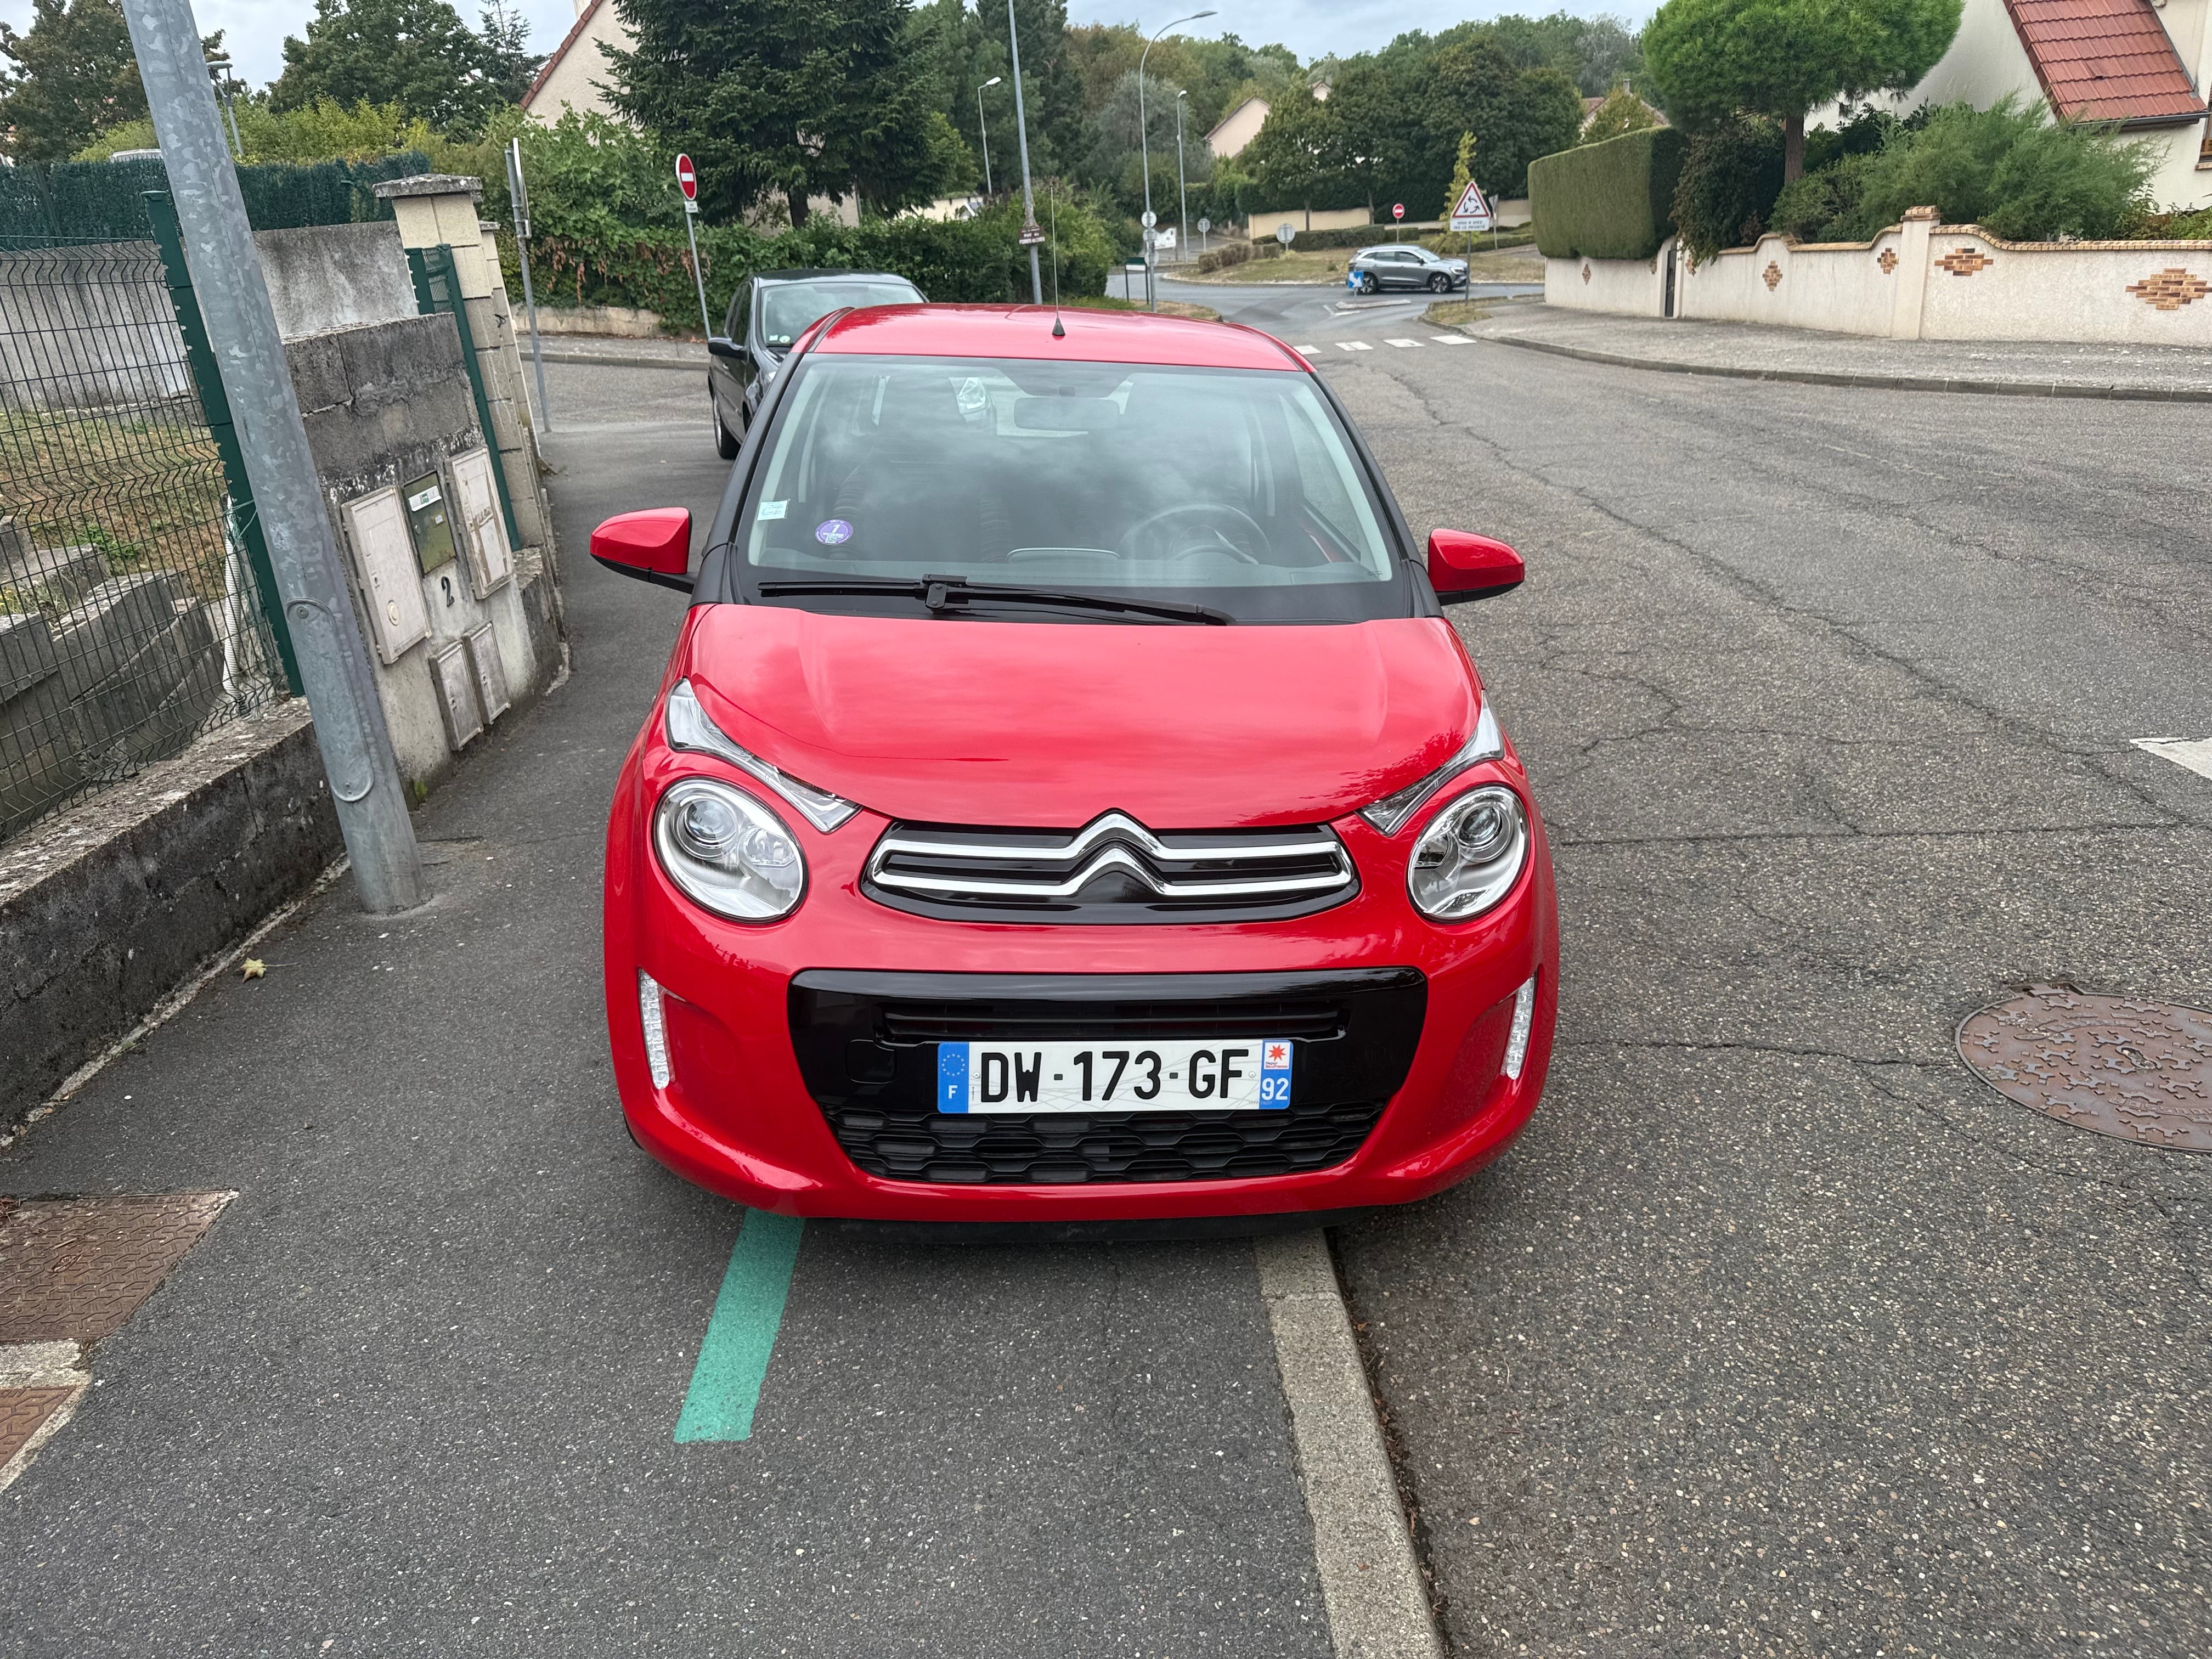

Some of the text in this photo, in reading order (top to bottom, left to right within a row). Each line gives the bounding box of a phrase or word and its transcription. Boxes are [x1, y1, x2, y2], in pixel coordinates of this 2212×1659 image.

[832, 524, 840, 533] 1
[441, 576, 455, 607] 2
[981, 1048, 1249, 1103] DW-173-GF
[948, 1085, 958, 1099] F
[1262, 1077, 1289, 1101] 92
